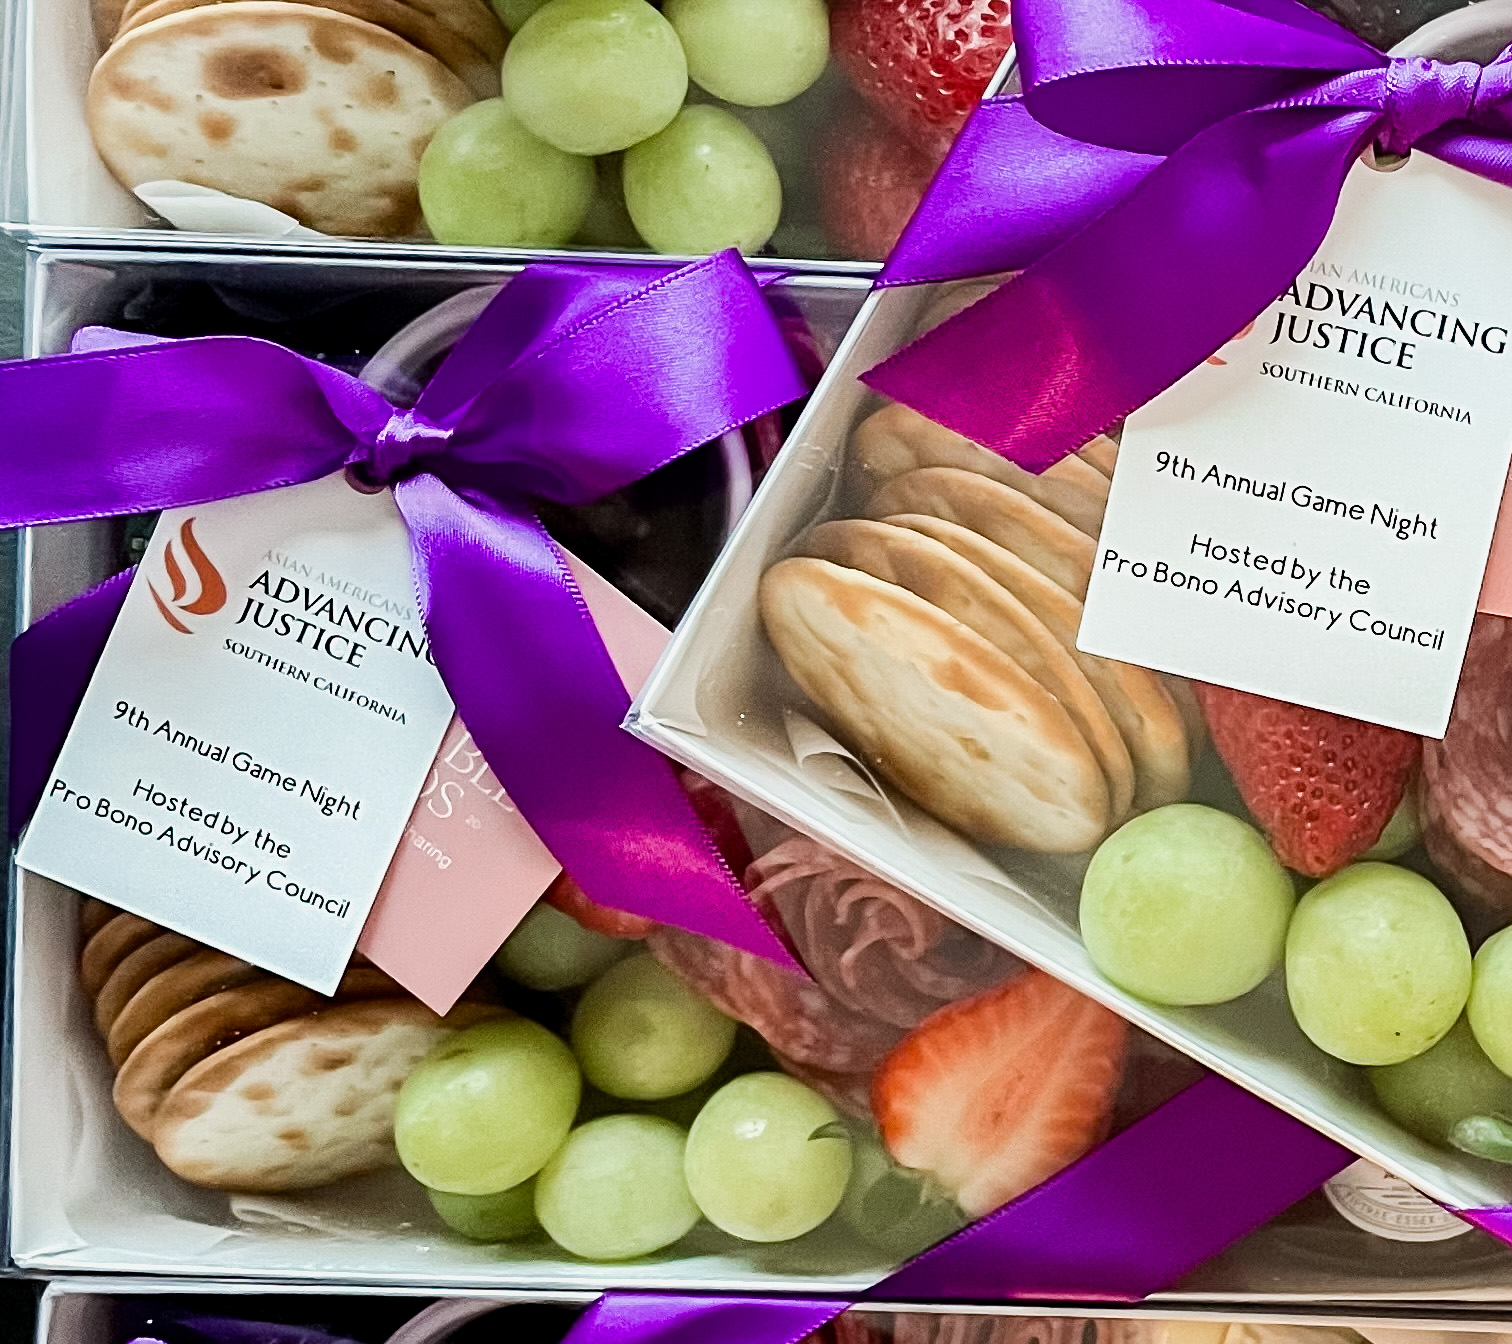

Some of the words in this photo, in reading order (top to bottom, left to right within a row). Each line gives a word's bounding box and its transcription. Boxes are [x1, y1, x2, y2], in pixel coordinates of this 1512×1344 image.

[1279, 280, 1508, 354] ADVANCING
[1309, 260, 1343, 278] IAN
[1348, 269, 1460, 306] AMERICANS
[1269, 313, 1416, 369] JUSTICE
[1260, 362, 1360, 396] SOUTHERN
[1365, 387, 1471, 424] CALIFORNIA
[1157, 451, 1196, 481] 9th
[1202, 465, 1286, 502] Annual
[1291, 485, 1365, 520] Game
[1371, 504, 1437, 540] Night
[262, 550, 313, 577] ASIAN
[317, 572, 413, 621] AMERICANS
[1103, 549, 1147, 577] Pro
[1154, 562, 1218, 595] Bono
[1224, 580, 1342, 630] Advisory
[1350, 610, 1444, 650] Council
[1190, 534, 1286, 575] Hosted
[1291, 559, 1321, 588] by
[1329, 567, 1371, 594] the
[236, 597, 367, 668] JUSTICE
[223, 639, 311, 683] SOUTHERN
[314, 677, 407, 725] CALIFORNIA
[113, 701, 149, 732] 9th
[153, 720, 230, 764] Annual
[232, 752, 296, 792] Game
[301, 780, 361, 820] Night
[50, 779, 91, 809] Pro
[95, 798, 152, 834] Bono
[157, 827, 261, 884] Advisory
[267, 871, 350, 918] Council
[133, 779, 217, 828] Hosted
[221, 816, 249, 844] by
[254, 829, 291, 858] the
